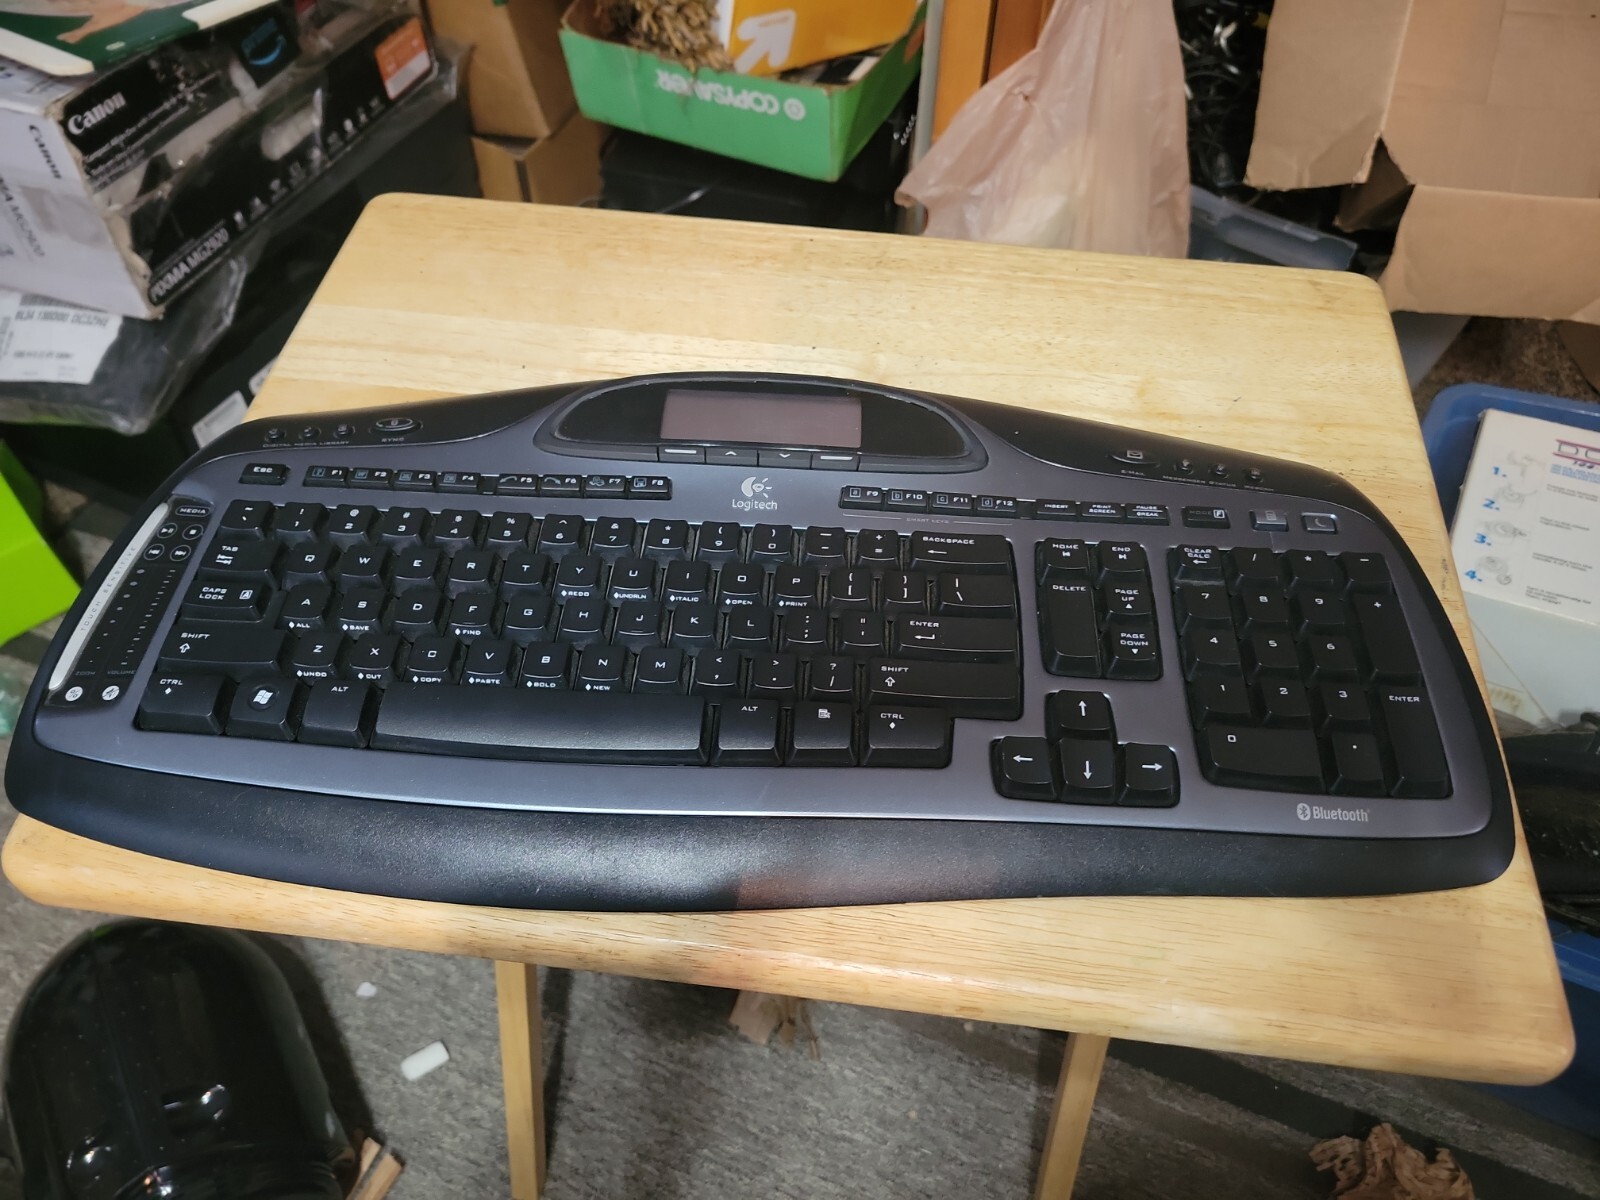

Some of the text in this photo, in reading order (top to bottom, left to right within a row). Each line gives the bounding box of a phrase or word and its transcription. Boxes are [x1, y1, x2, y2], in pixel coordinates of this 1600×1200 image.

[67, 91, 126, 136] Canon
[28, 123, 62, 180] Canon
[732, 499, 778, 511] Logitech
[923, 536, 974, 544] BACKSPACE
[1313, 806, 1369, 823] Bluetooth
